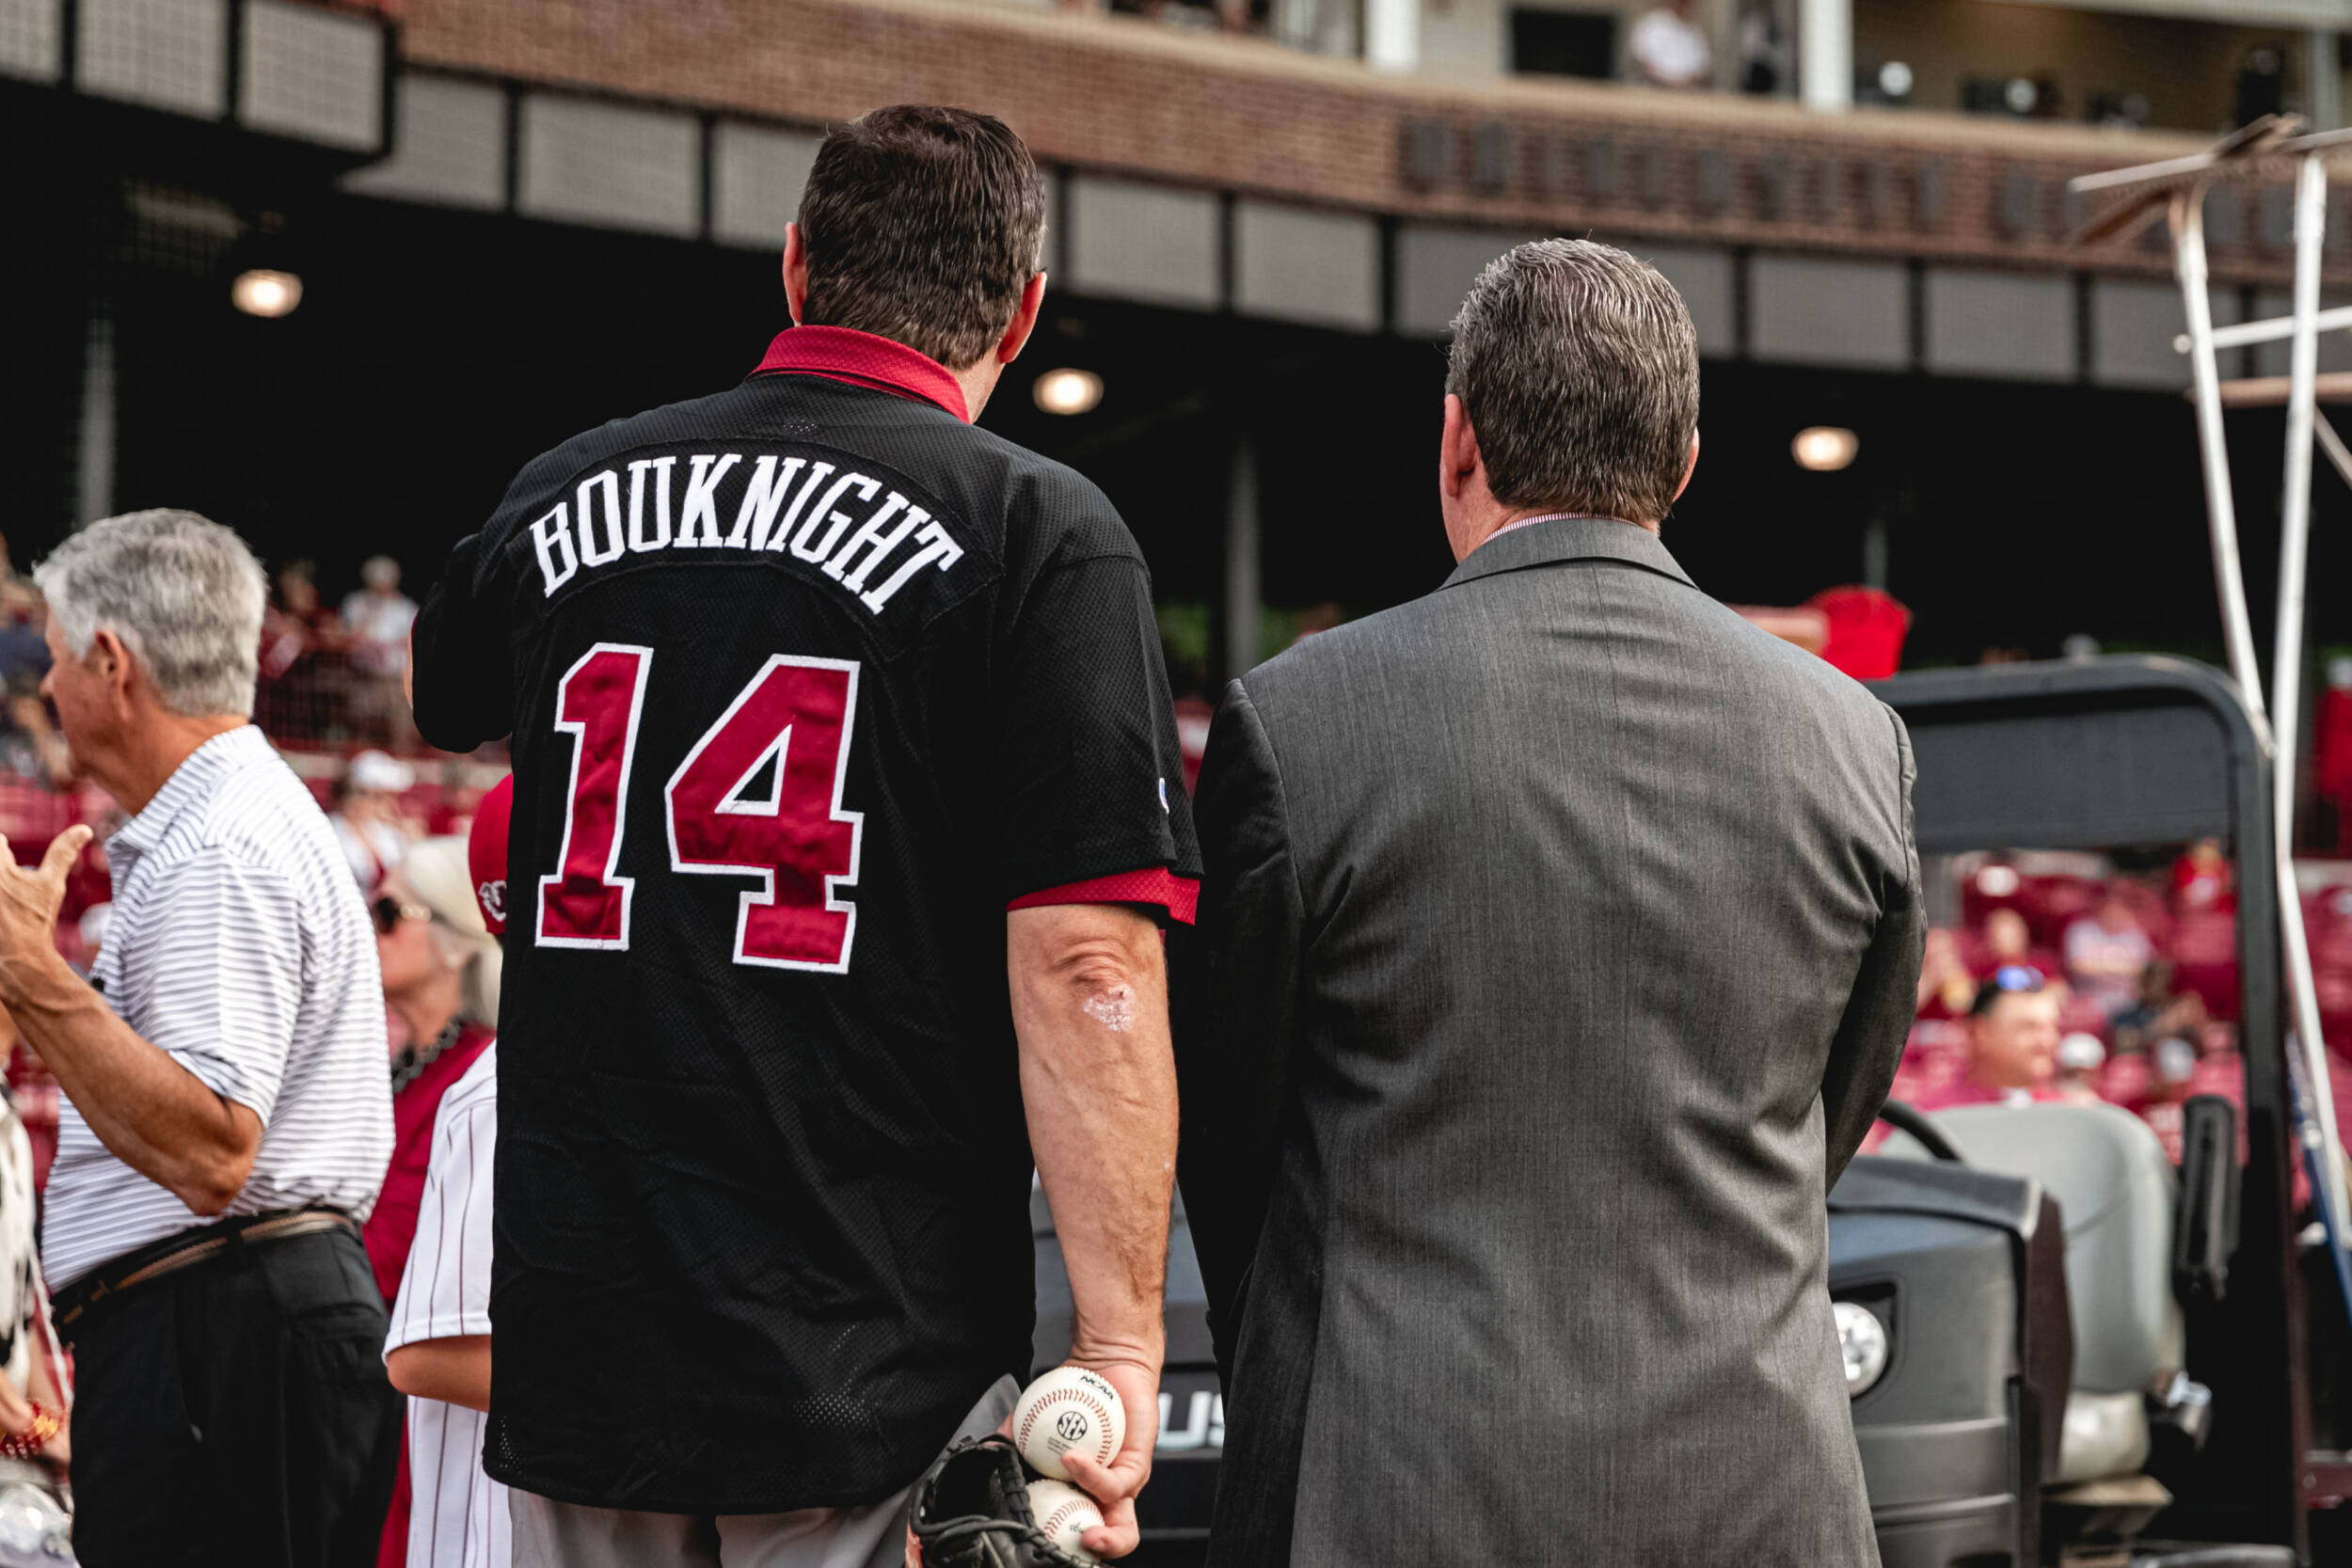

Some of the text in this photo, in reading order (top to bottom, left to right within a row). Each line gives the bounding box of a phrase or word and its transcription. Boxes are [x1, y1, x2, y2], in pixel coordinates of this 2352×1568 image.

[530, 452, 964, 615] BOUKNIGHT
[534, 641, 865, 974] 14
[1057, 1411, 1088, 1441] SEC
[1080, 1375, 1113, 1401] NCAA
